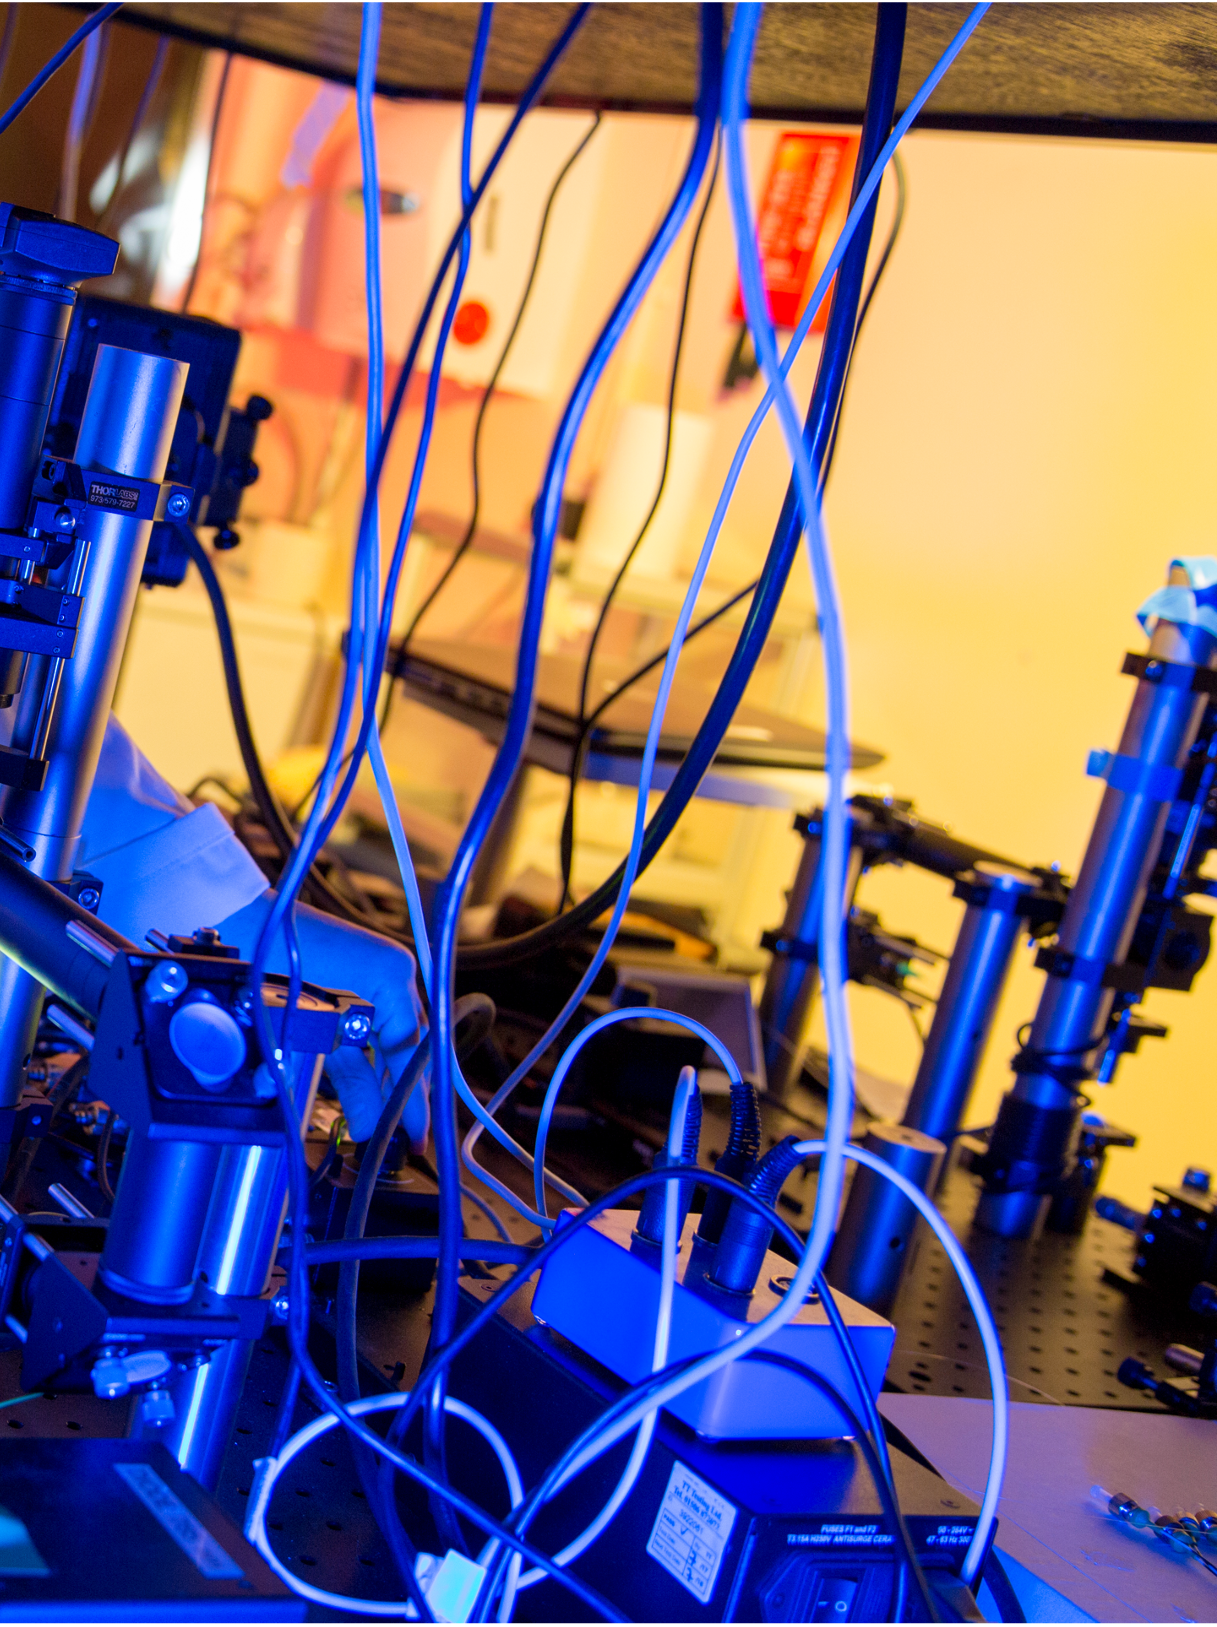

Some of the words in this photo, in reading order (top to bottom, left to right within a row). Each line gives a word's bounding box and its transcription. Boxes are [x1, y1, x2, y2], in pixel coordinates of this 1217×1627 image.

[91, 484, 135, 500] THORLABS
[821, 1524, 844, 1533] FUSES
[844, 1524, 854, 1533] F1
[854, 1524, 867, 1533] and
[833, 1534, 872, 1542] ANTISURGE
